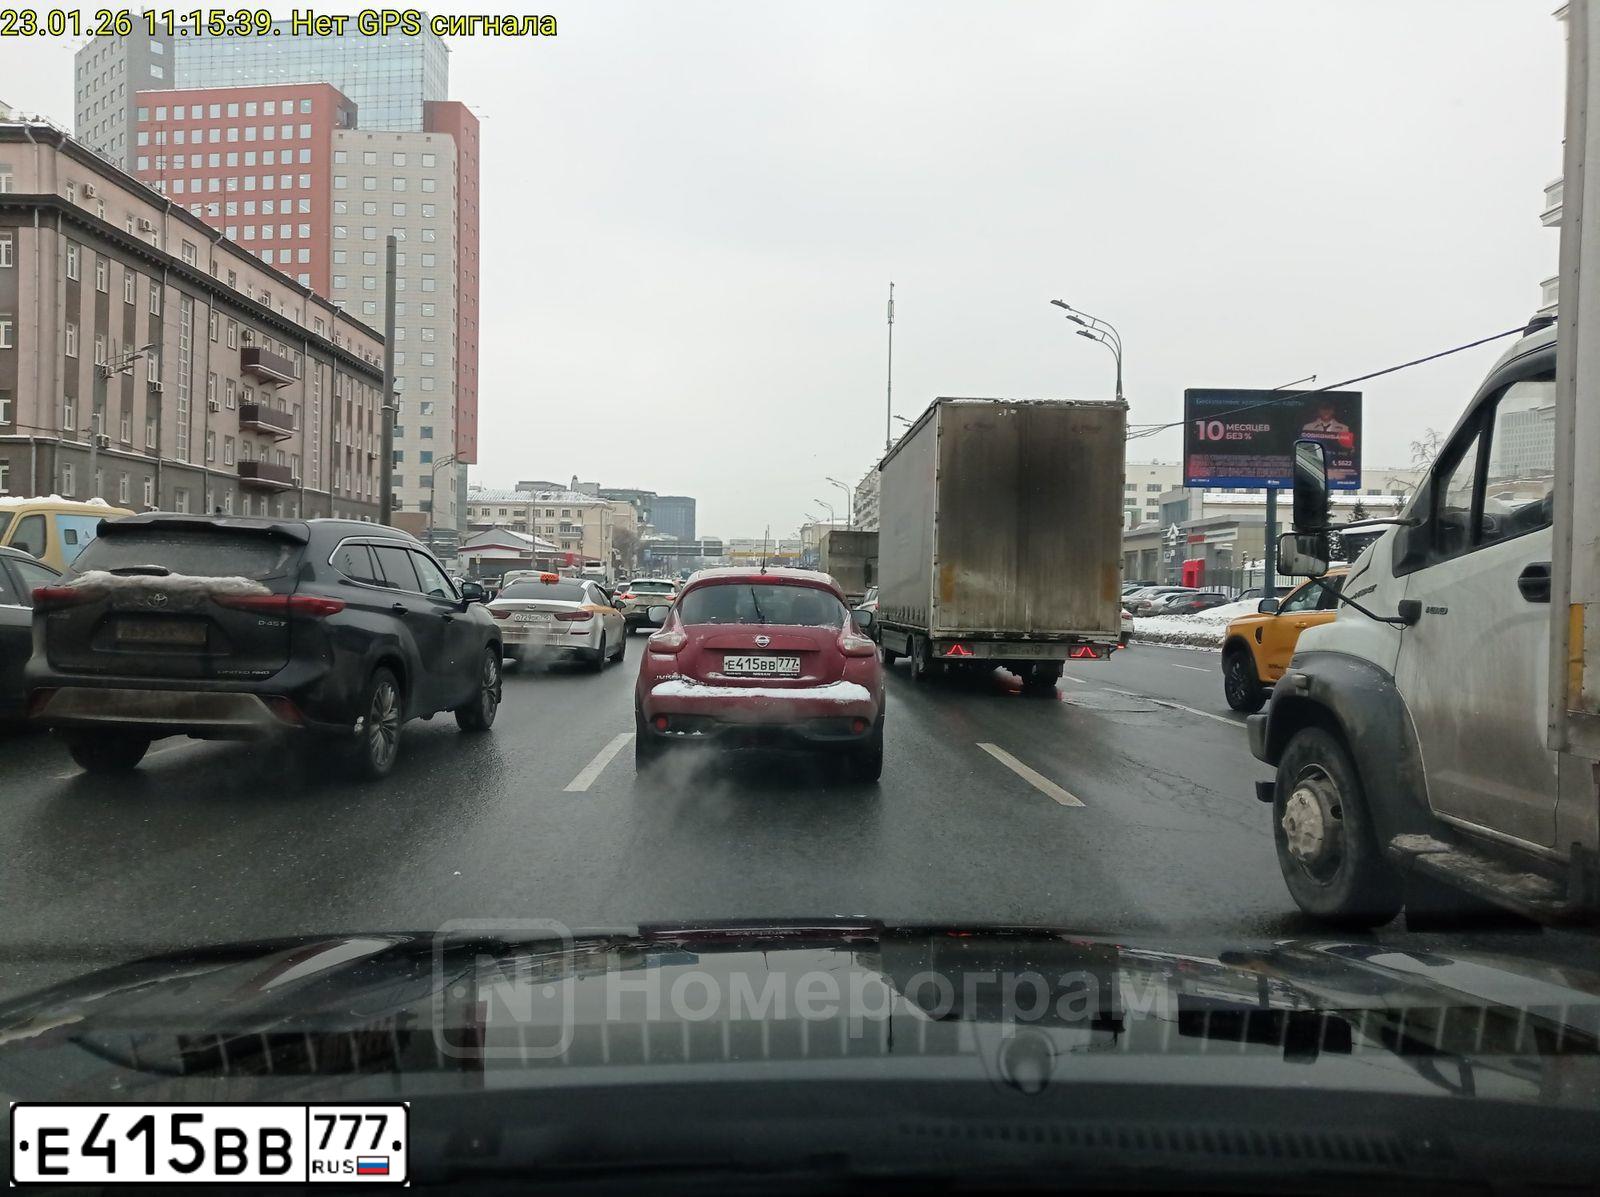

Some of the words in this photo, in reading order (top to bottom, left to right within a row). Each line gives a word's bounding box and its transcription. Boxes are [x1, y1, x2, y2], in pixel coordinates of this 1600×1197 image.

[1196, 420, 1225, 441] 10
[1226, 423, 1270, 433] МЕСЯЦЕВ
[1226, 432, 1243, 440] БЕЗ
[727, 658, 776, 671] Е415ВВ
[778, 658, 797, 668] 777
